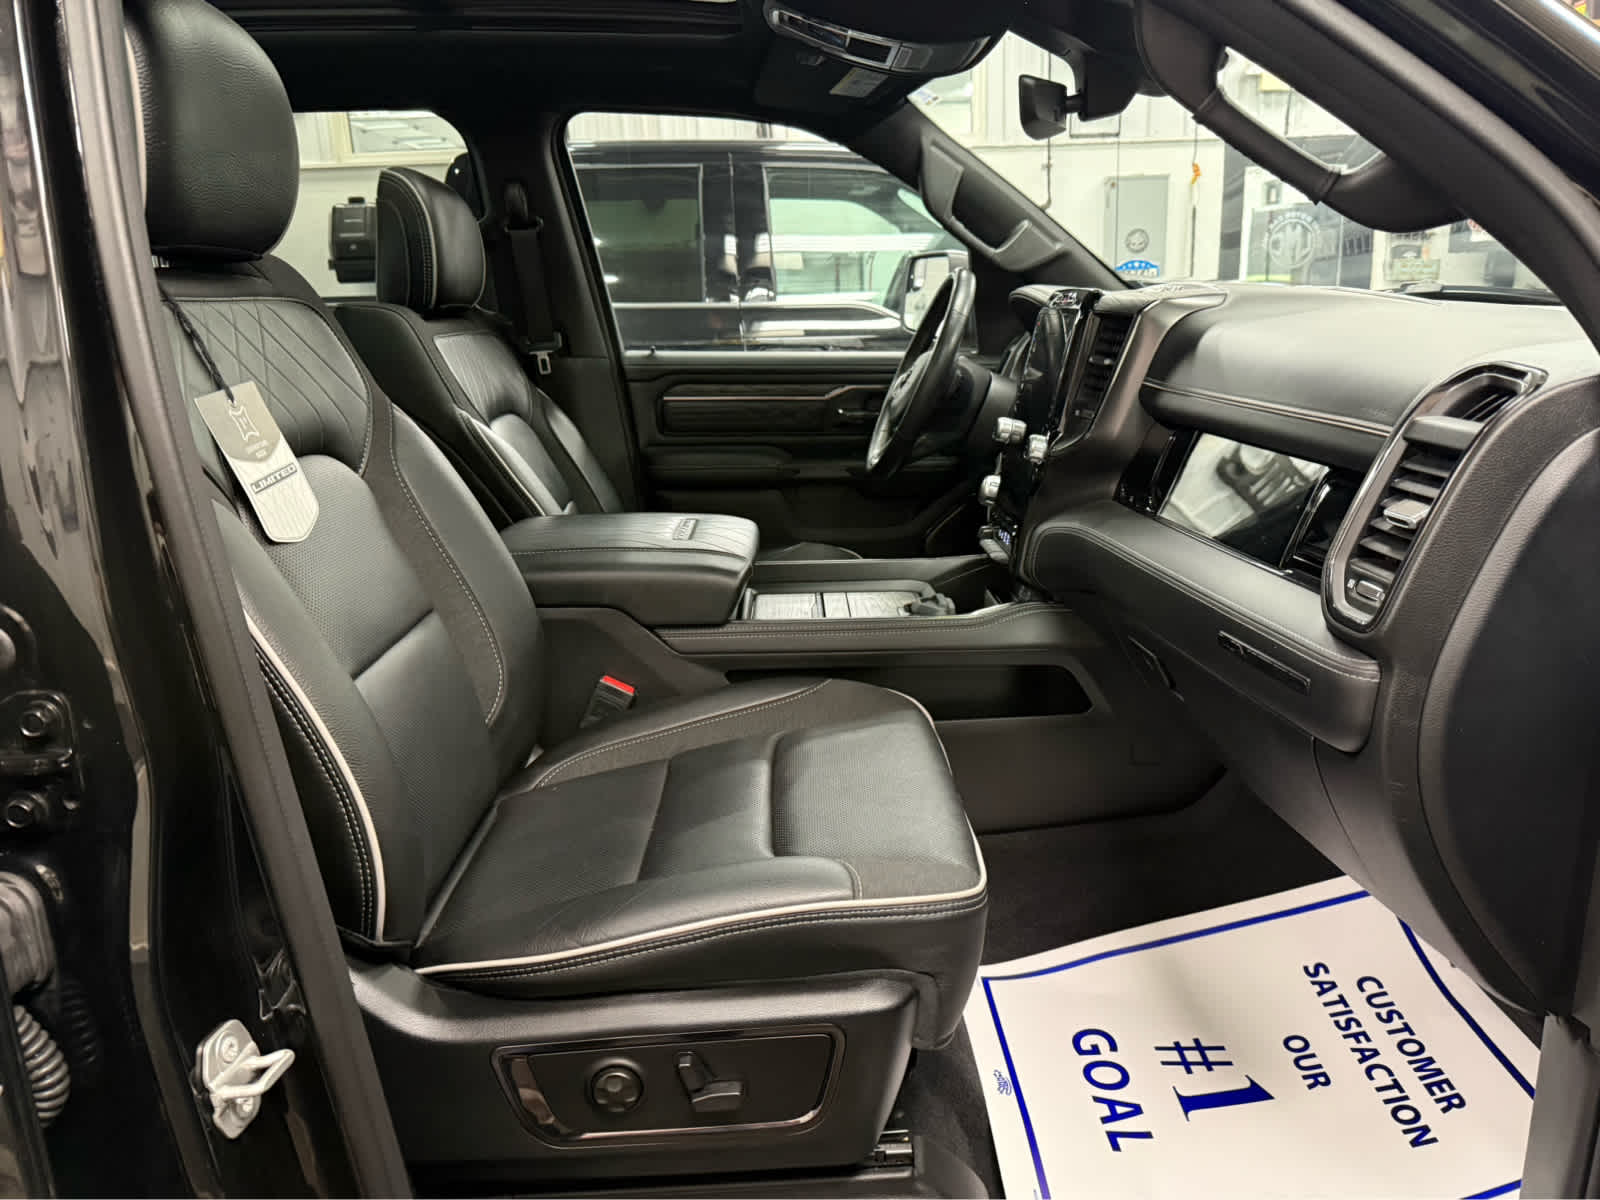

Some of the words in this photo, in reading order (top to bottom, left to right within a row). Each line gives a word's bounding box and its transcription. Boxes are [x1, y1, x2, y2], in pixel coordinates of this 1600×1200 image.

[1071, 1028, 1154, 1152] GOAL
[1154, 1037, 1276, 1122] #1
[1282, 1034, 1332, 1091] OUR
[1303, 962, 1440, 1149] SATISFACTION
[1356, 975, 1467, 1115] CUSTOMER
